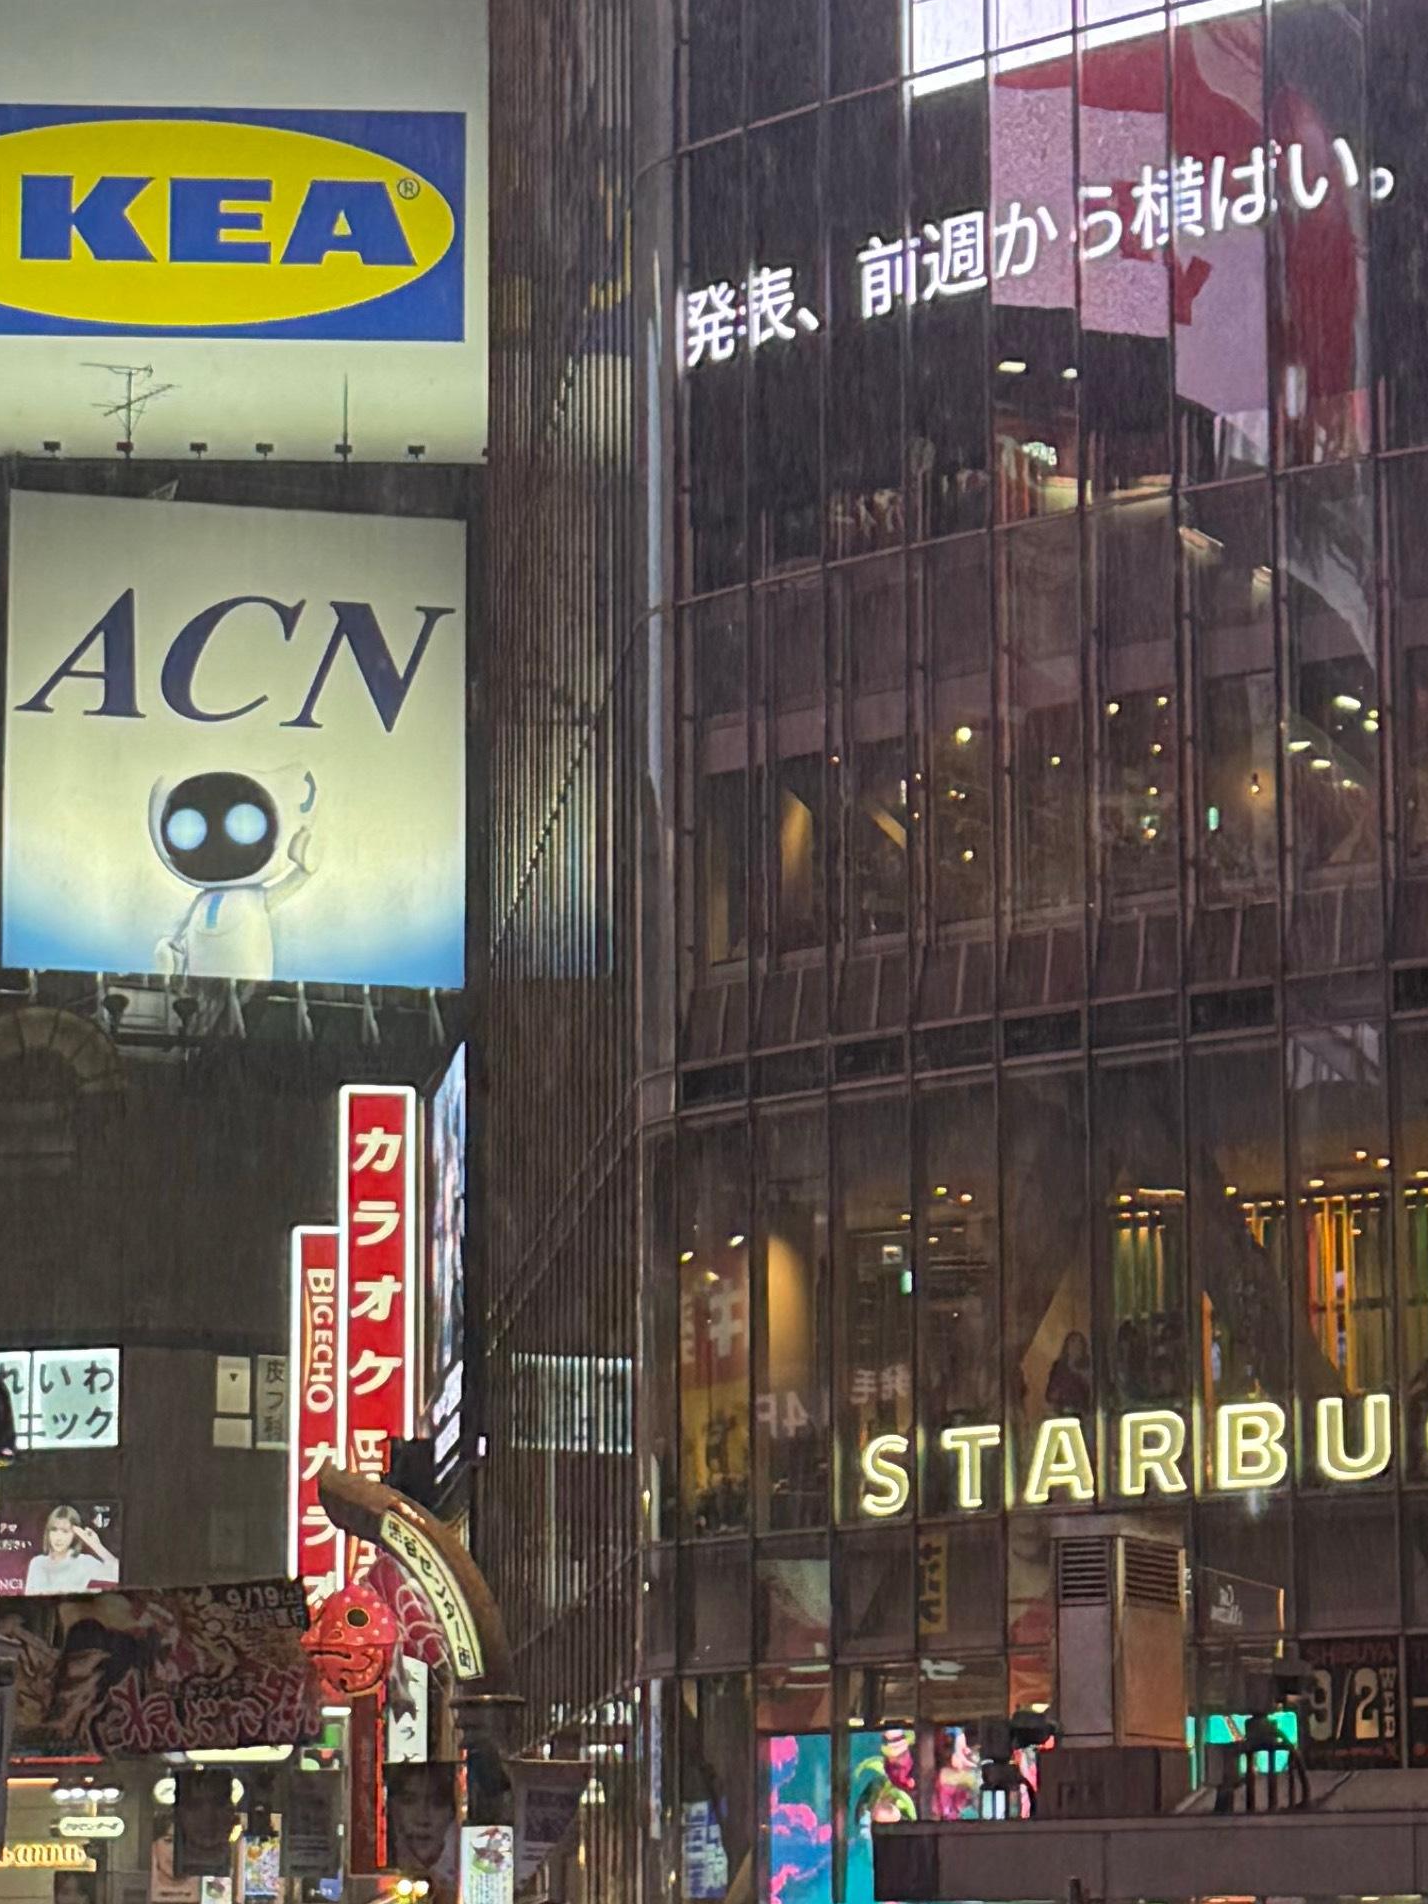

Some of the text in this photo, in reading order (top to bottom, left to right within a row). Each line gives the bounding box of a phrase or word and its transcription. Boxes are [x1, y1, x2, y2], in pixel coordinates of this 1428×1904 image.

[15, 586, 456, 733] ACN
[349, 1126, 403, 1396] カラオケ
[15, 1405, 114, 1441] ニック
